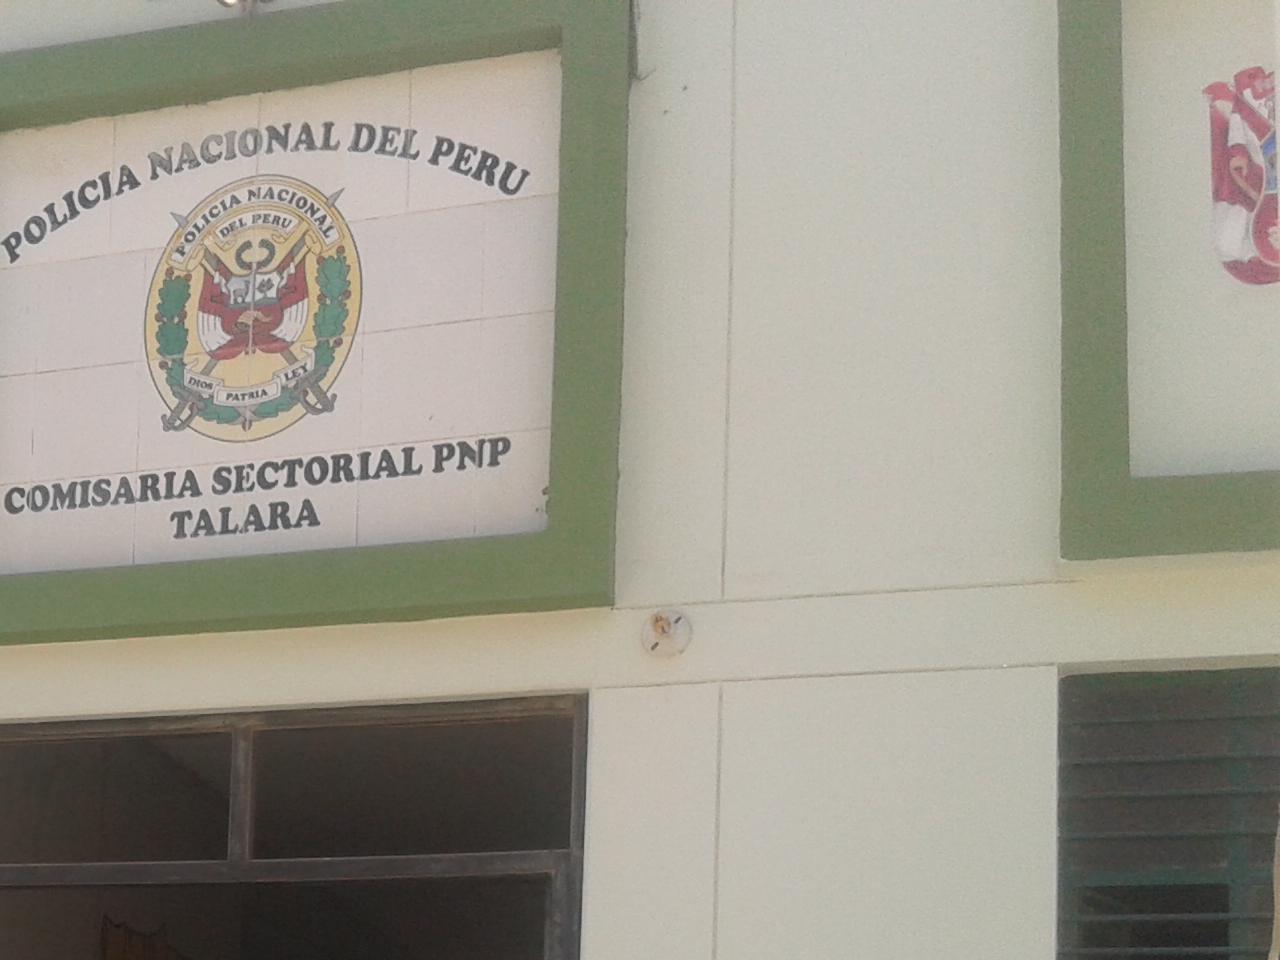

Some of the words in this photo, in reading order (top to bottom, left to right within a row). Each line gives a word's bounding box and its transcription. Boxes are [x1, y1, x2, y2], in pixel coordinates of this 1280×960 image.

[0, 165, 140, 263] POLICIA
[148, 121, 340, 181] NACIONAL
[349, 121, 420, 161] DEL
[427, 134, 531, 199] PERU
[174, 194, 242, 259] POLICIA
[247, 186, 335, 239] NACIONAL
[219, 221, 247, 239] DEL
[251, 214, 293, 230] PERU
[187, 374, 214, 391] DIOS
[284, 362, 310, 381] LEY
[224, 388, 269, 402] PATRIA
[3, 469, 203, 515] COMISARIA
[211, 446, 423, 497] SECTORIAL
[432, 436, 512, 474] PNP
[170, 498, 321, 540] TALARA
